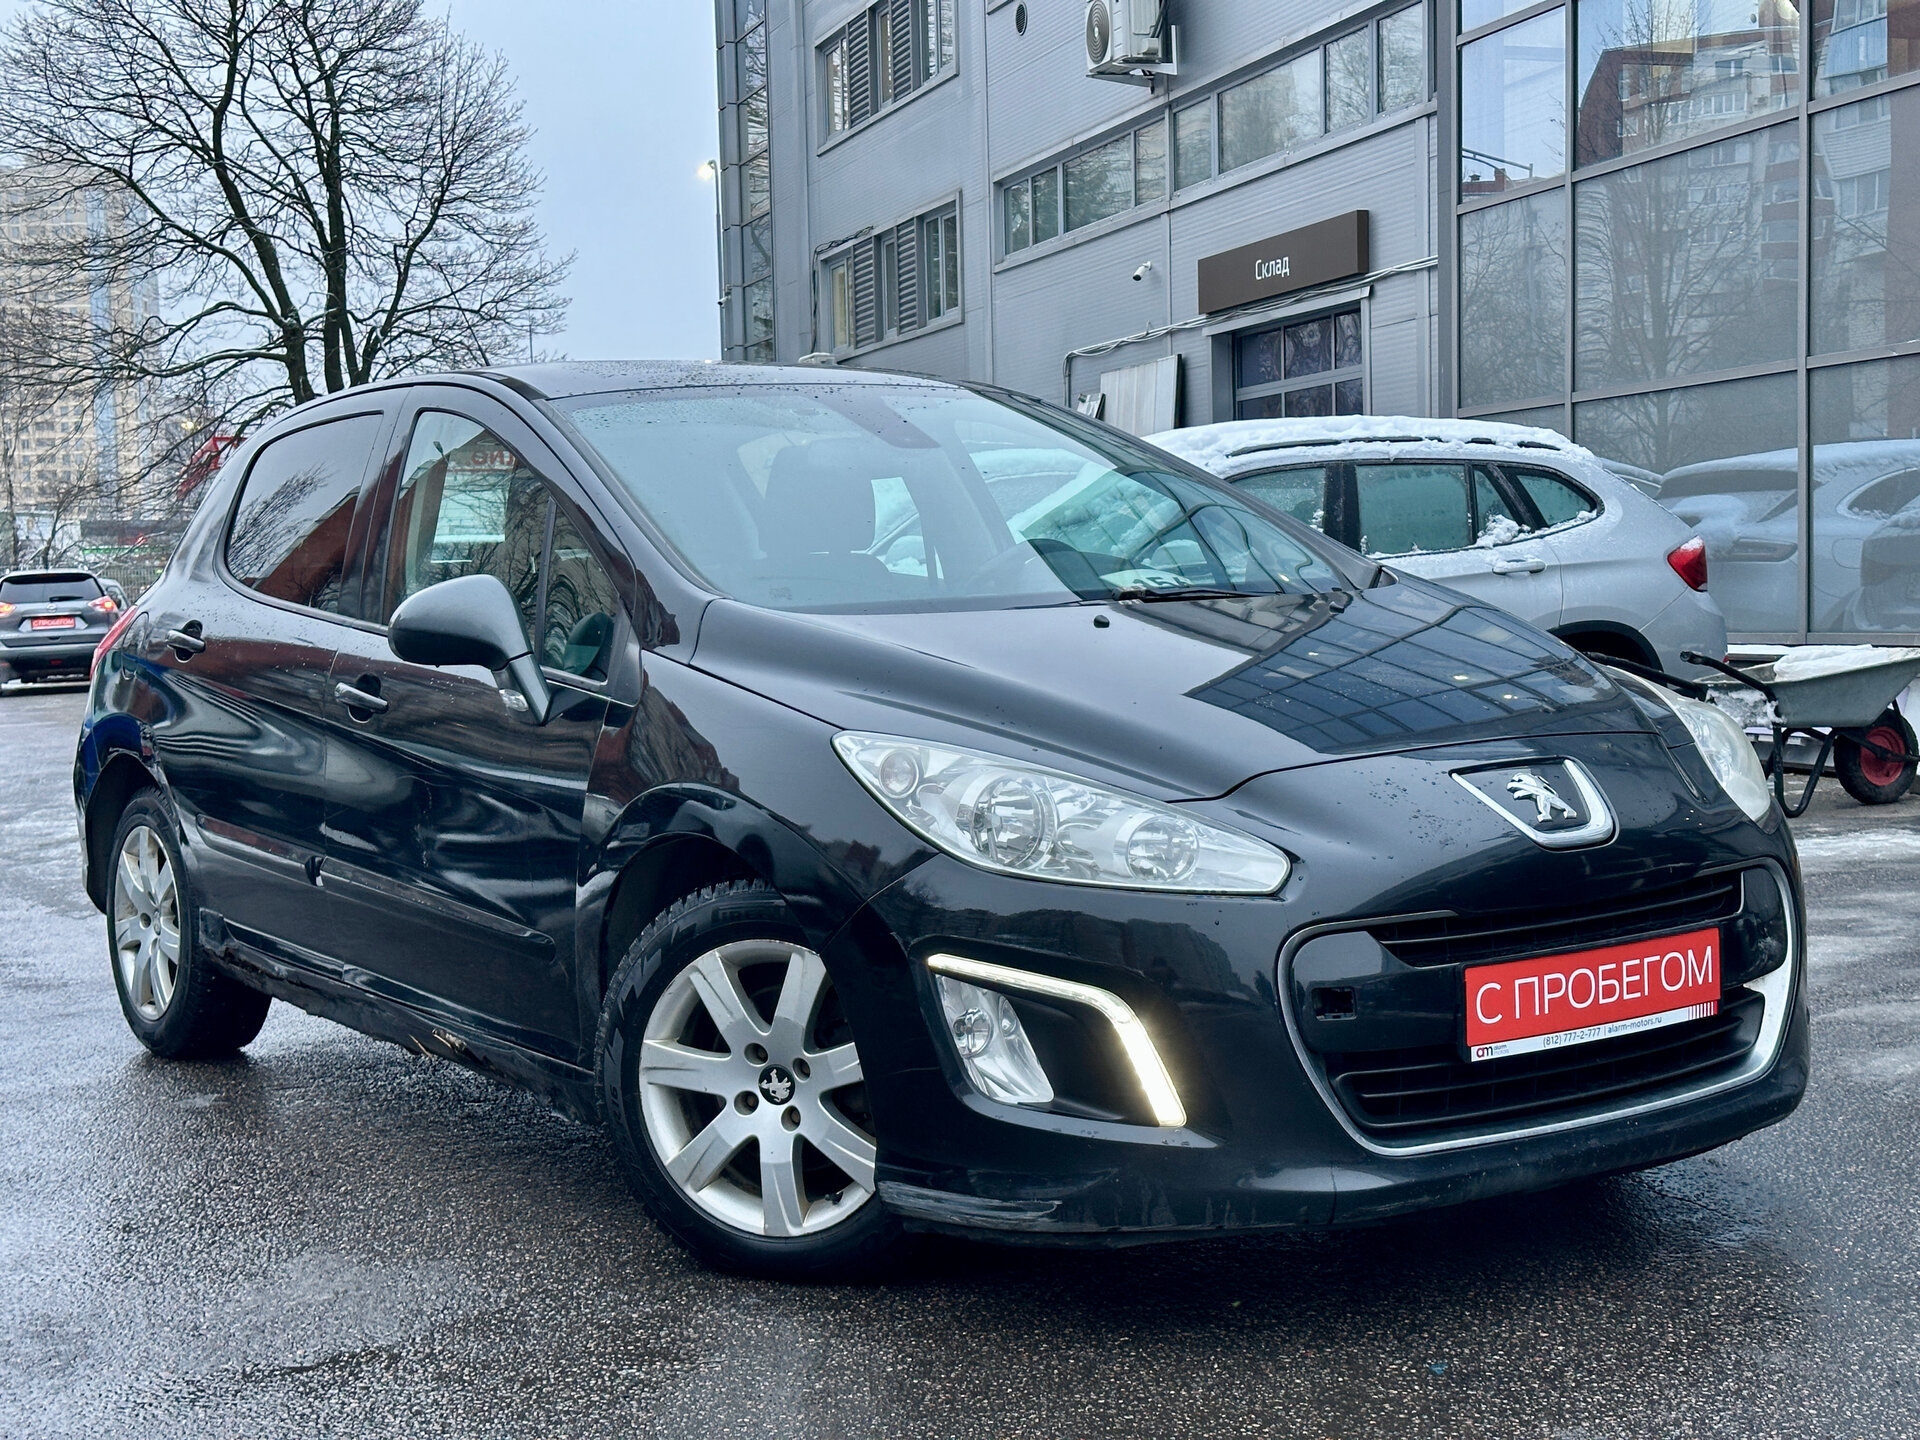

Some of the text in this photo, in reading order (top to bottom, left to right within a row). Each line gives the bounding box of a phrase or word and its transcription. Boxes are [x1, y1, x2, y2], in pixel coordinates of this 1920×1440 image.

[1255, 256, 1290, 280] Склад
[1475, 945, 1713, 1024] С ПРОБЕГОМ
[1543, 1016, 1663, 1048] (812) 777-2-777 alarm-motors.ru
